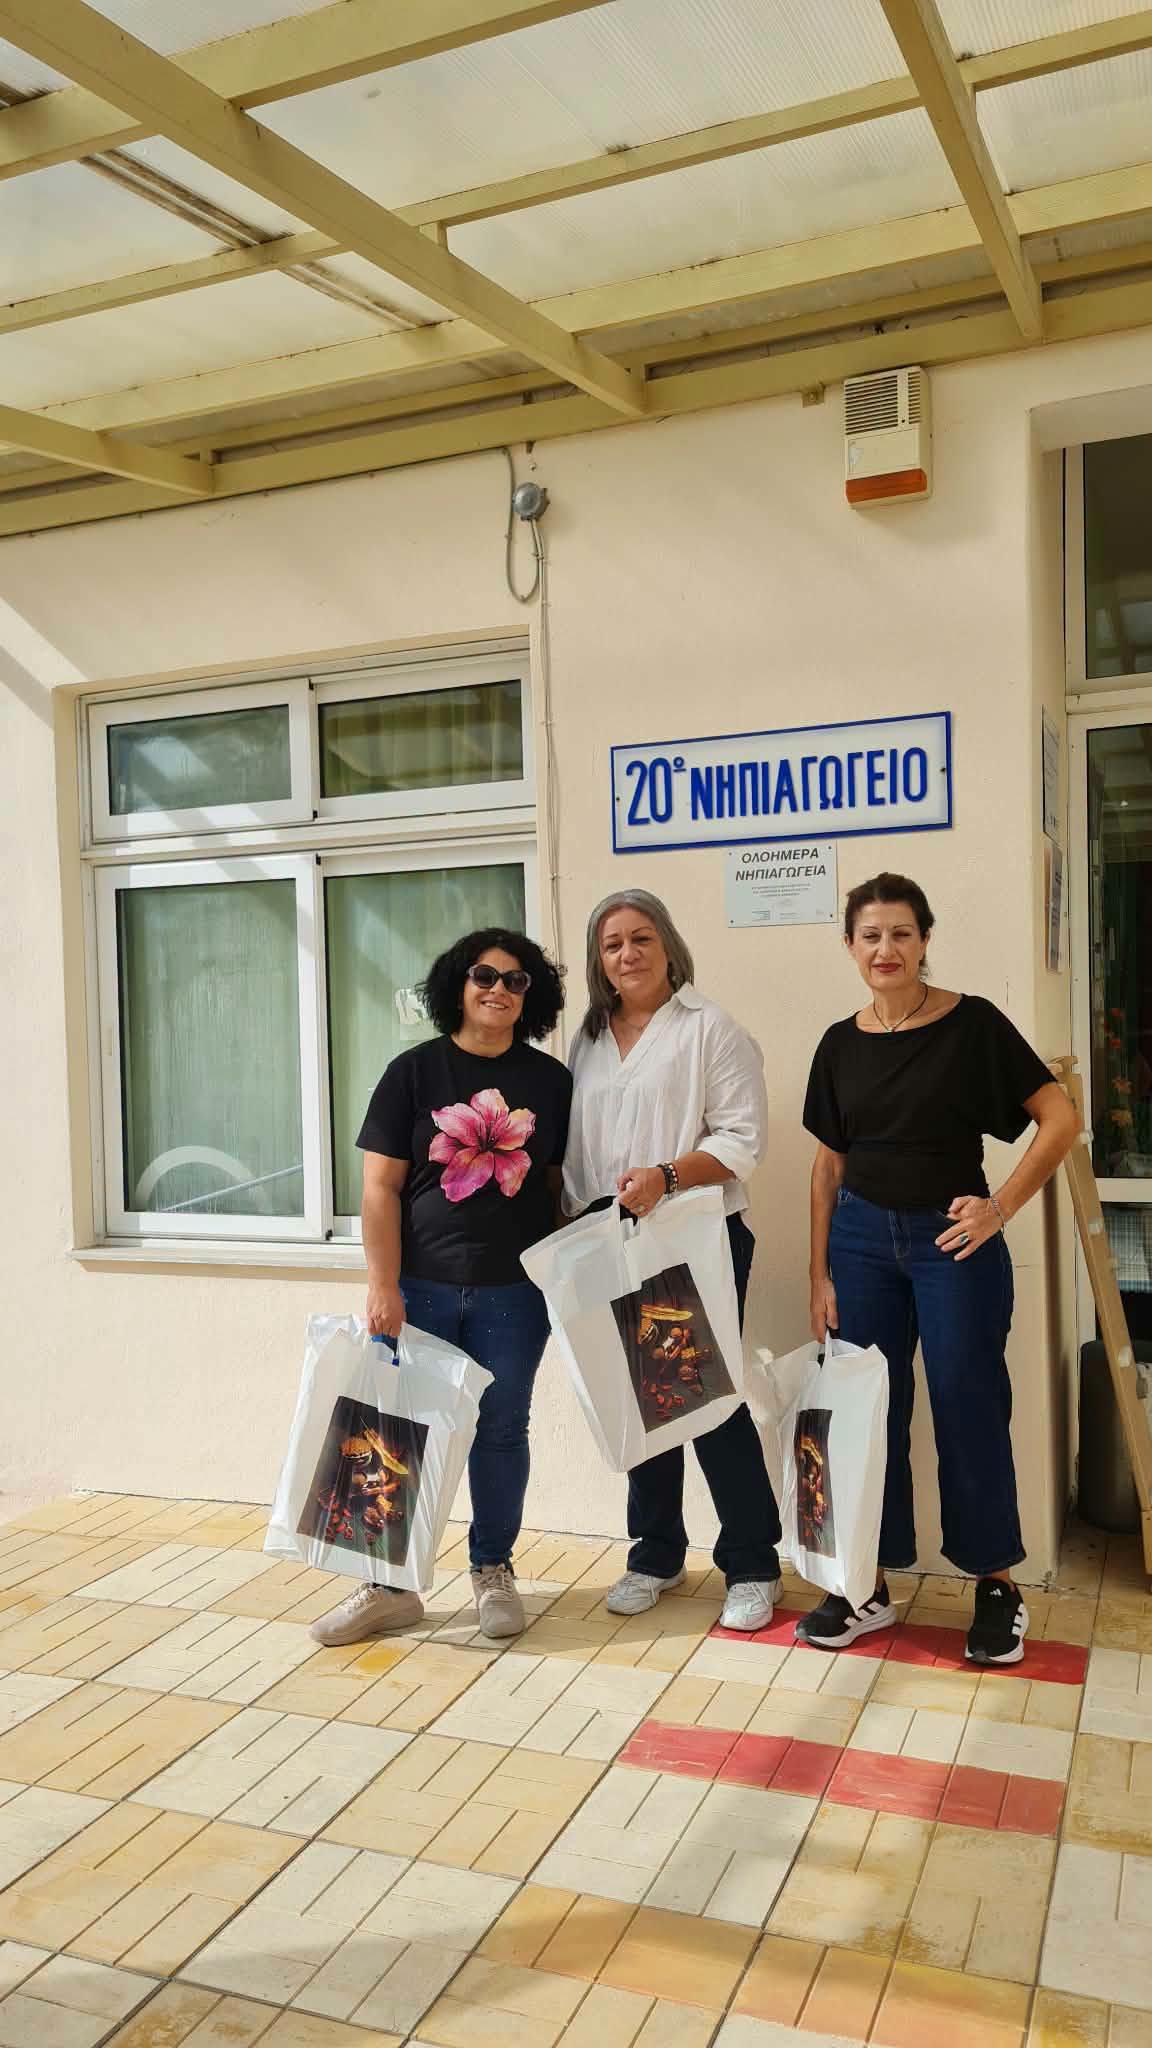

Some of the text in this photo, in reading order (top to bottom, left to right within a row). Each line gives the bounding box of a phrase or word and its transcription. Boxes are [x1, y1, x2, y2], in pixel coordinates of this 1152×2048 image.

[690, 747, 928, 820] ΝΗΠΙΑΓΩΓΕΙΟ
[741, 847, 819, 864] ΟΛΟΗΜΕΡΑ
[735, 864, 827, 881] ΝΗΠΙΑΓΩΓΕΙΑ
